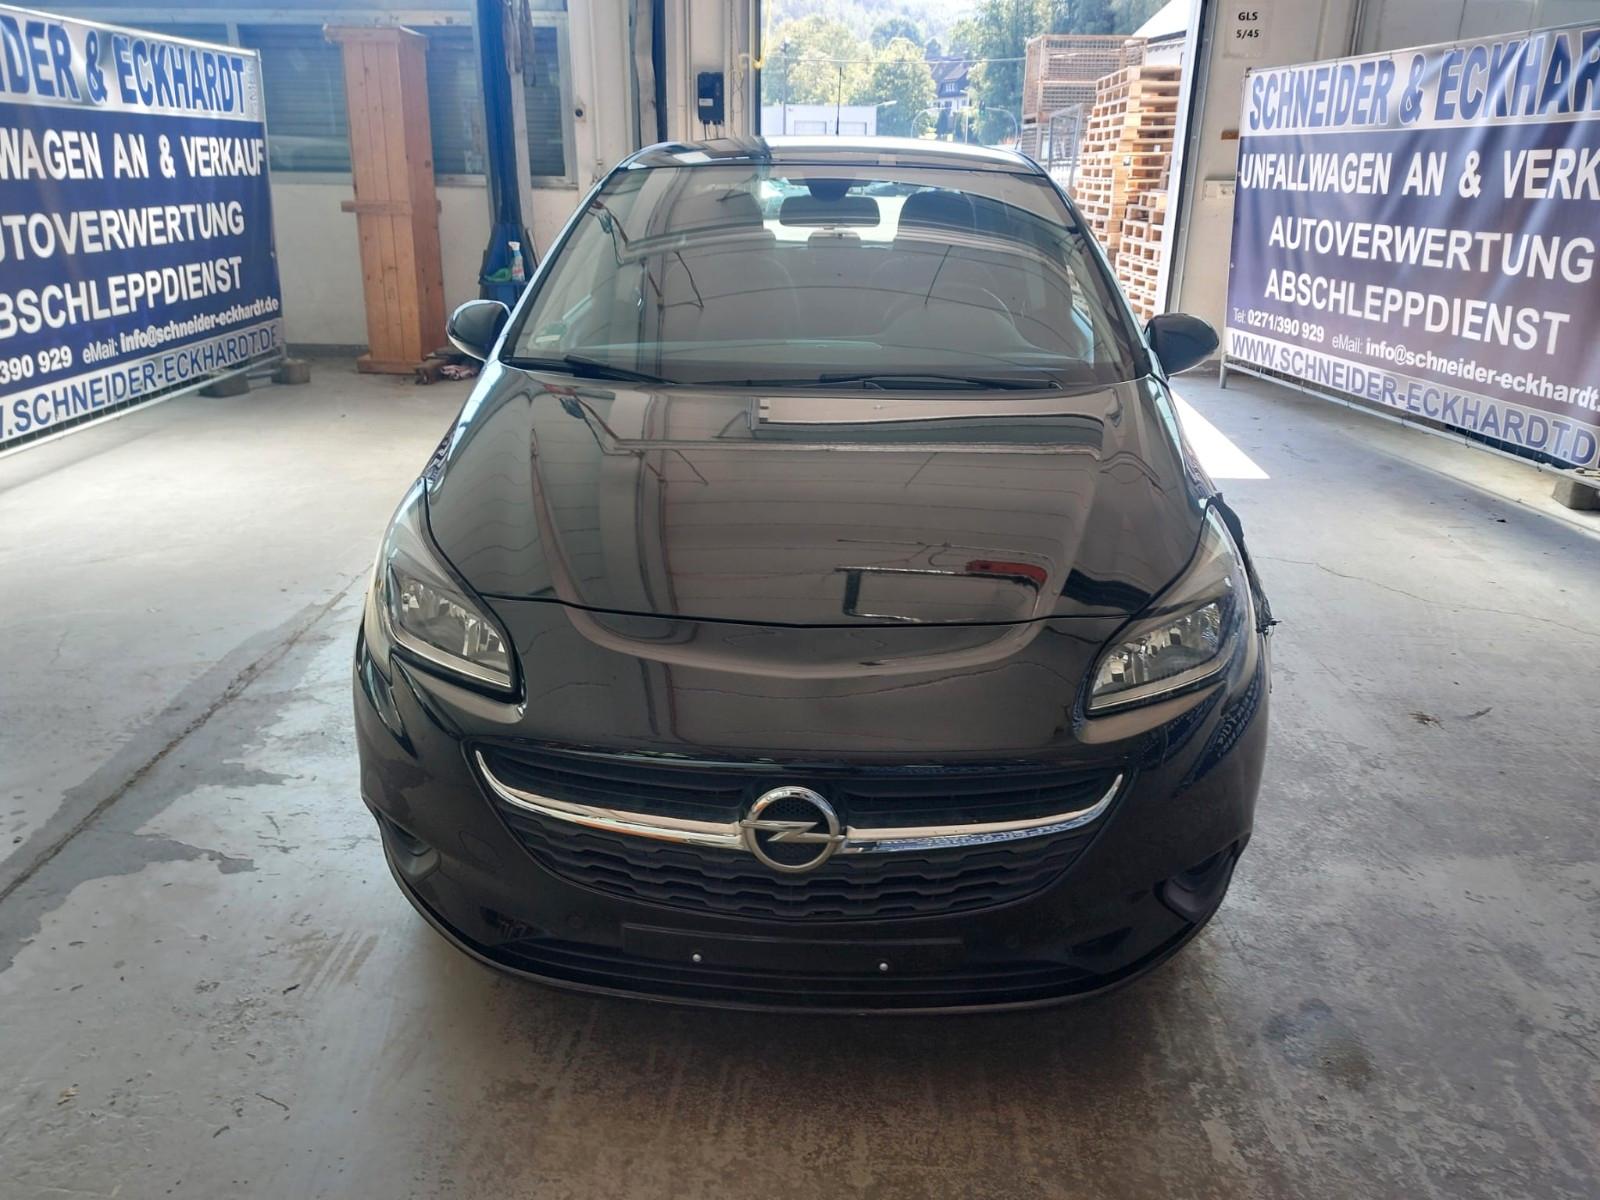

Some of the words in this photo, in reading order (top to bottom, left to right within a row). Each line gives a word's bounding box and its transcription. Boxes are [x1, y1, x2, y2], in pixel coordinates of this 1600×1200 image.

[1236, 29, 1260, 39] 5/45
[1238, 11, 1258, 22] GLS
[86, 31, 107, 103] &
[111, 35, 244, 114] ECKHARDT
[1250, 61, 1395, 130] SCHNEIDER
[1399, 54, 1427, 125] &
[114, 133, 149, 179] AN
[159, 134, 176, 178] &
[181, 136, 264, 177] VERKAUF
[1241, 153, 1392, 195] UNFALLWAGEN
[1402, 152, 1447, 196] AN
[1459, 150, 1481, 198] &
[1504, 148, 1600, 200] VERK
[1269, 216, 1595, 284] AUTOVERWERTUNG
[0, 256, 242, 339] BSCHLEPPDIENST
[1233, 307, 1246, 324] Tel:
[1247, 309, 1300, 336] 0271/390
[1301, 320, 1325, 343] 929
[1332, 333, 1362, 355] eMail:
[1264, 268, 1570, 355] ABSCHLEPPDIENST
[0, 354, 34, 384] 390
[38, 345, 72, 374] 929
[83, 337, 119, 364] eMail:
[120, 297, 279, 352] info@schneider-eckhardt.de
[0, 325, 278, 438] .SCHNEIDER-ECKHARDT.DE
[1232, 333, 1600, 468] WWW.SCHNEIDER-ECKHARDT.D
